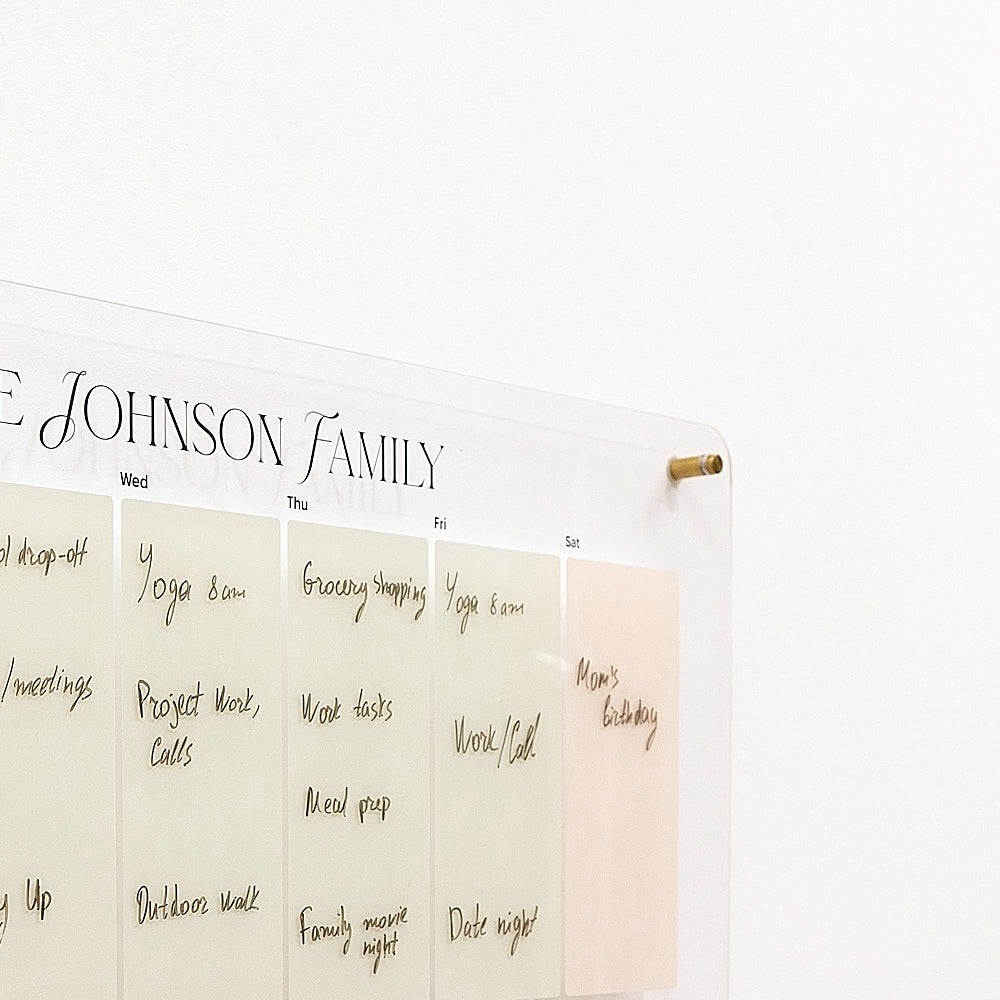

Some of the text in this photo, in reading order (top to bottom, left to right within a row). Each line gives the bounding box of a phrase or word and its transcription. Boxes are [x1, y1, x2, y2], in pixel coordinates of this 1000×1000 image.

[39, 370, 284, 467] JOHNSON
[297, 410, 445, 490] FAMILY
[120, 472, 148, 489] Wed
[287, 496, 308, 511] Thu
[434, 517, 447, 530] Fri
[18, 536, 88, 575] drop-off
[565, 536, 580, 548] Sat
[138, 542, 191, 625] Yoga
[303, 561, 368, 622] Grocery
[446, 572, 479, 634] Yoga
[137, 680, 204, 729] Project
[302, 689, 393, 724] Work tasks
[602, 698, 658, 750] birthday
[150, 736, 193, 767] Calls
[305, 787, 390, 823] Meal prep
[26, 879, 51, 921] Up
[136, 884, 209, 925] Outdoor
[300, 905, 409, 955] Family movie
[448, 903, 538, 956] Date night
[363, 930, 399, 974] night
